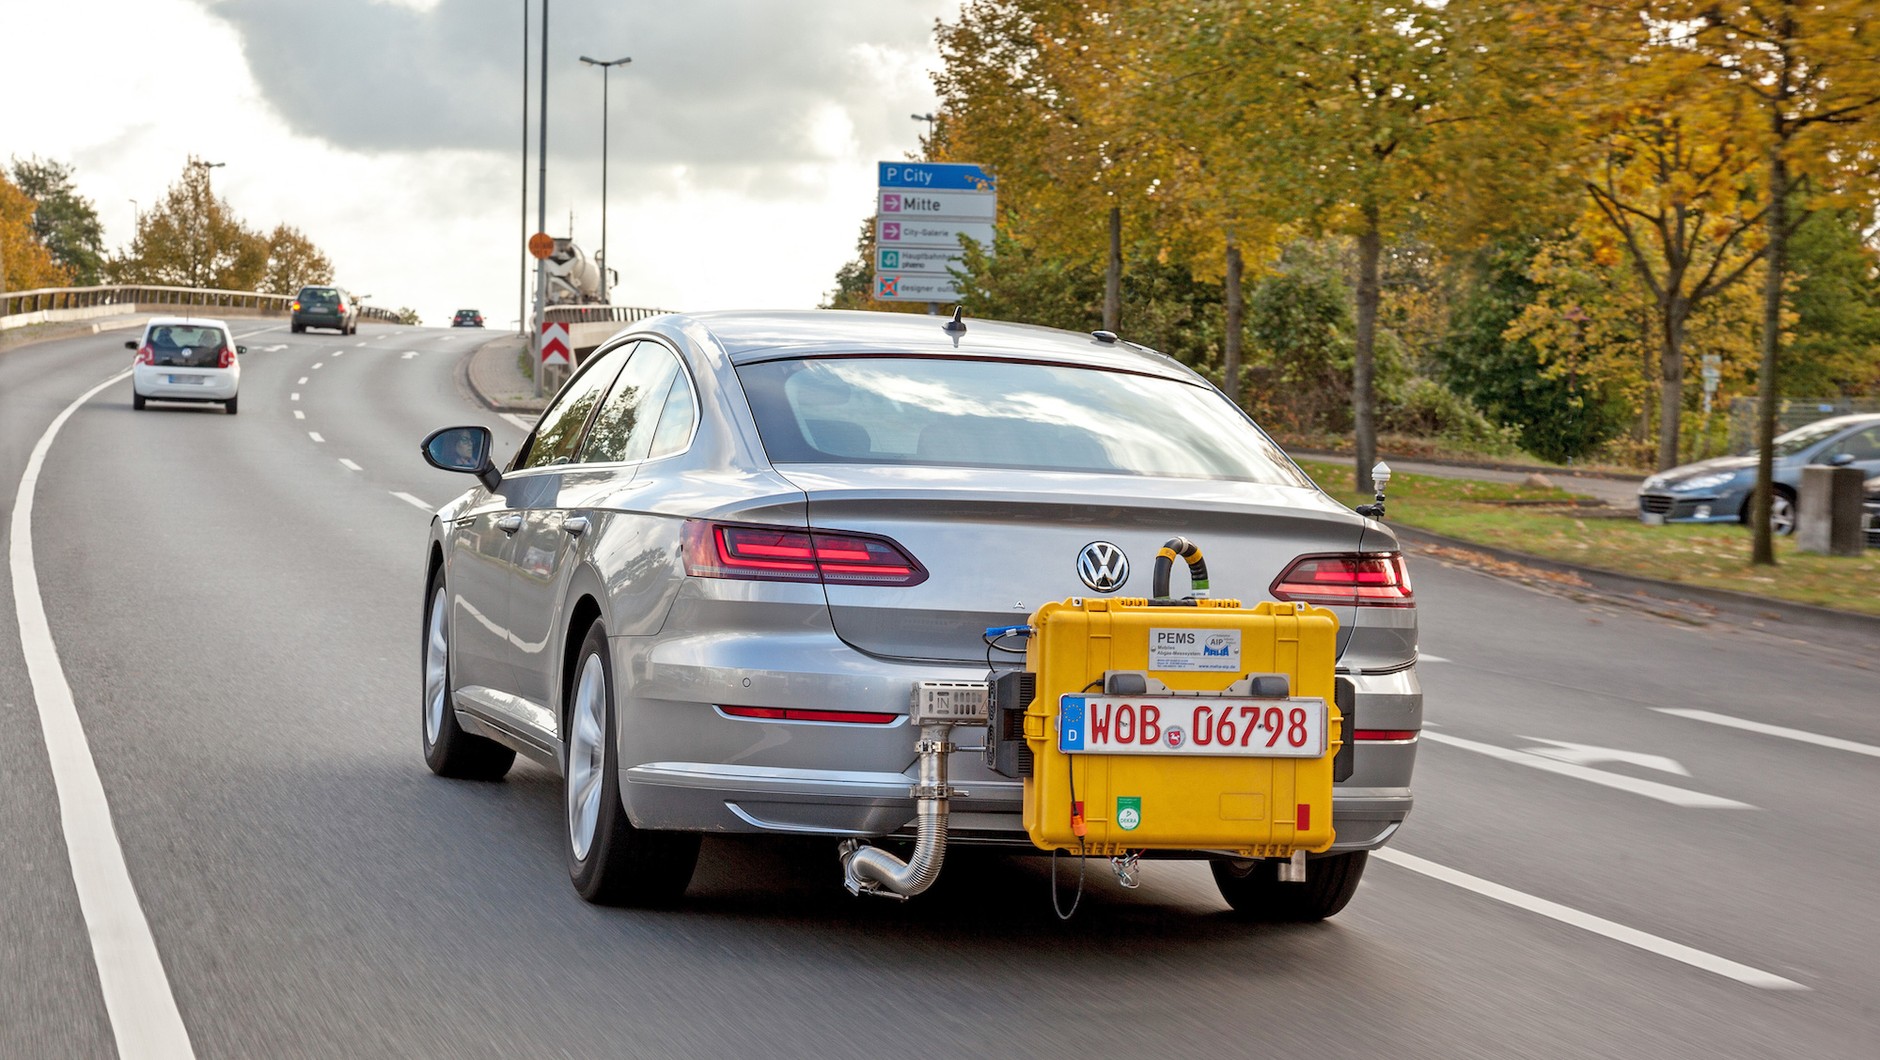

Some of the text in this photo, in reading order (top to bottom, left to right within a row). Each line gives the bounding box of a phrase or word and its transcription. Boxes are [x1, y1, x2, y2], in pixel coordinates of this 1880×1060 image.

[887, 167, 933, 186] P City
[903, 197, 941, 212] Mitte
[903, 228, 949, 238] City-Galerie
[901, 284, 933, 293] designer
[1157, 632, 1196, 645] PEMS
[1210, 638, 1224, 646] AIP
[937, 697, 950, 709] IN
[1091, 703, 1308, 748] WOB 06798
[1067, 729, 1078, 742] D
